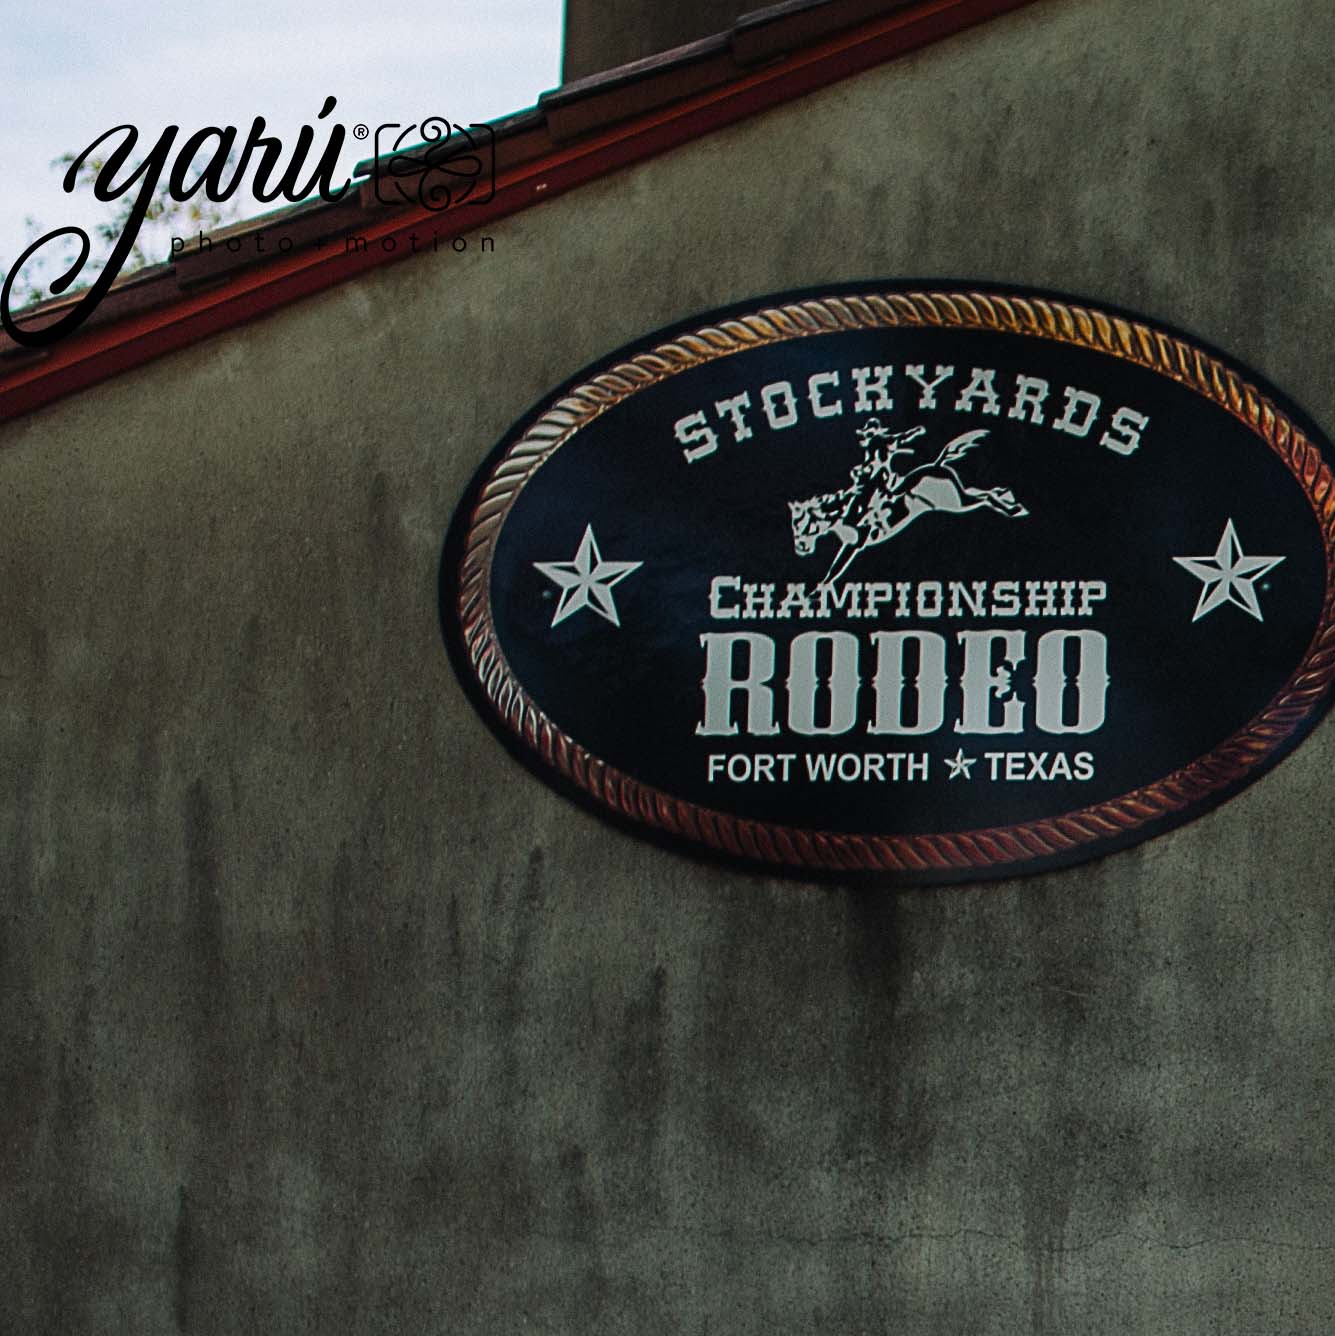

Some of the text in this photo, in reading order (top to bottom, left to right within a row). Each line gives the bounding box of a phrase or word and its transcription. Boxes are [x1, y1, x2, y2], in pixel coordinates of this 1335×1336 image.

[672, 364, 1150, 466] STOCKYARDS
[708, 575, 1108, 620] CHAMPIONSHIP
[694, 629, 1111, 737] RODEO
[707, 751, 1095, 783] FORT WORTH TEXAS
